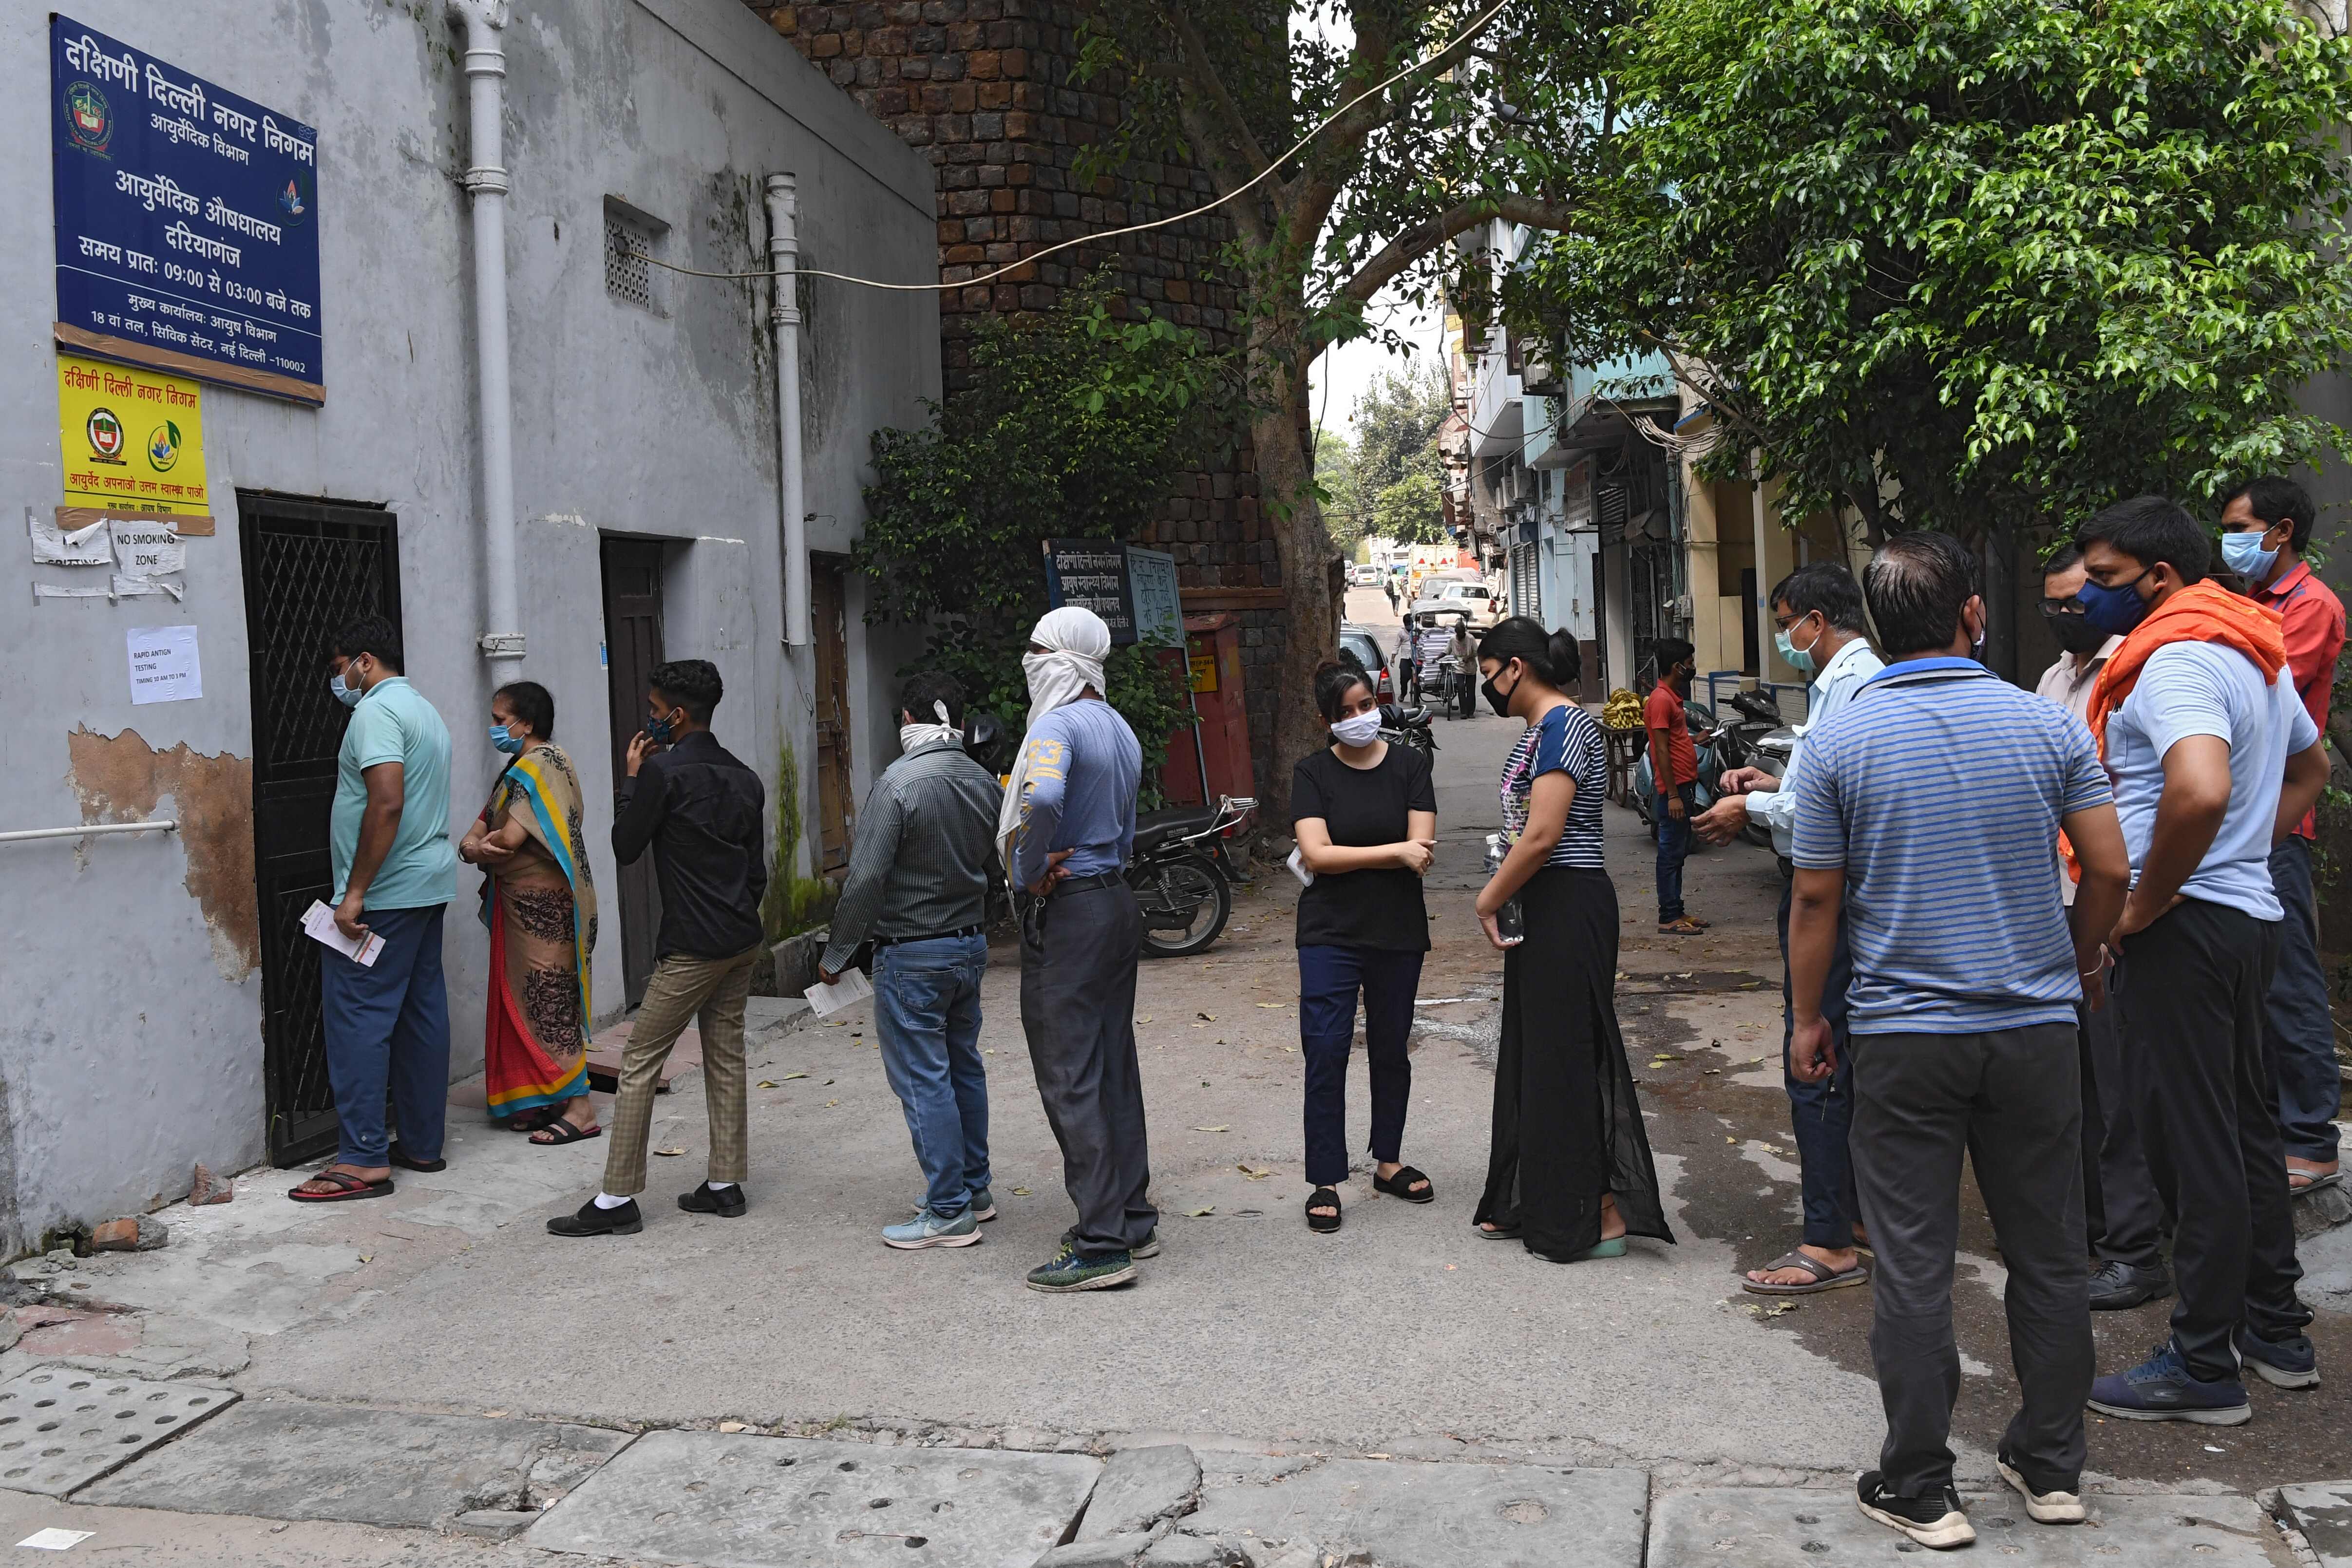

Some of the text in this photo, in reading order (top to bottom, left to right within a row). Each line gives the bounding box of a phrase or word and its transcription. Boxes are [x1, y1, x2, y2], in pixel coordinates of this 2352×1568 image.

[65, 35, 314, 167] दक्षिणी दिल्ली नगर निगम
[151, 113, 249, 165] आयुर्वेदिक विभाग
[116, 170, 281, 246] आयुर्वेदिक औषधालय
[165, 221, 241, 268] दरियागंज
[78, 236, 121, 264] समय
[165, 263, 203, 288] 09:00
[208, 268, 221, 293] से
[227, 281, 262, 305] 03:00
[266, 289, 286, 312] बजे
[290, 300, 311, 319] तक
[92, 311, 104, 324] 18
[125, 319, 148, 337] तल,
[152, 321, 188, 343] सिविक
[221, 341, 236, 359] नई
[239, 343, 266, 363] दिल्ली
[128, 294, 156, 311] मुख्य
[211, 316, 242, 337] आयुष
[245, 321, 277, 343] विभाग
[64, 366, 197, 409] दक्षिणी दिल्ली नगर निगम
[70, 471, 100, 491] आयुर्वेद
[104, 476, 136, 491] अपनाओ
[139, 481, 157, 494] उत्तम
[187, 484, 204, 499] पाओ
[117, 534, 174, 545] NO SMOKING
[136, 555, 158, 565] ZONE
[135, 663, 157, 672] TESTING
[151, 649, 171, 657] ANTIGN
